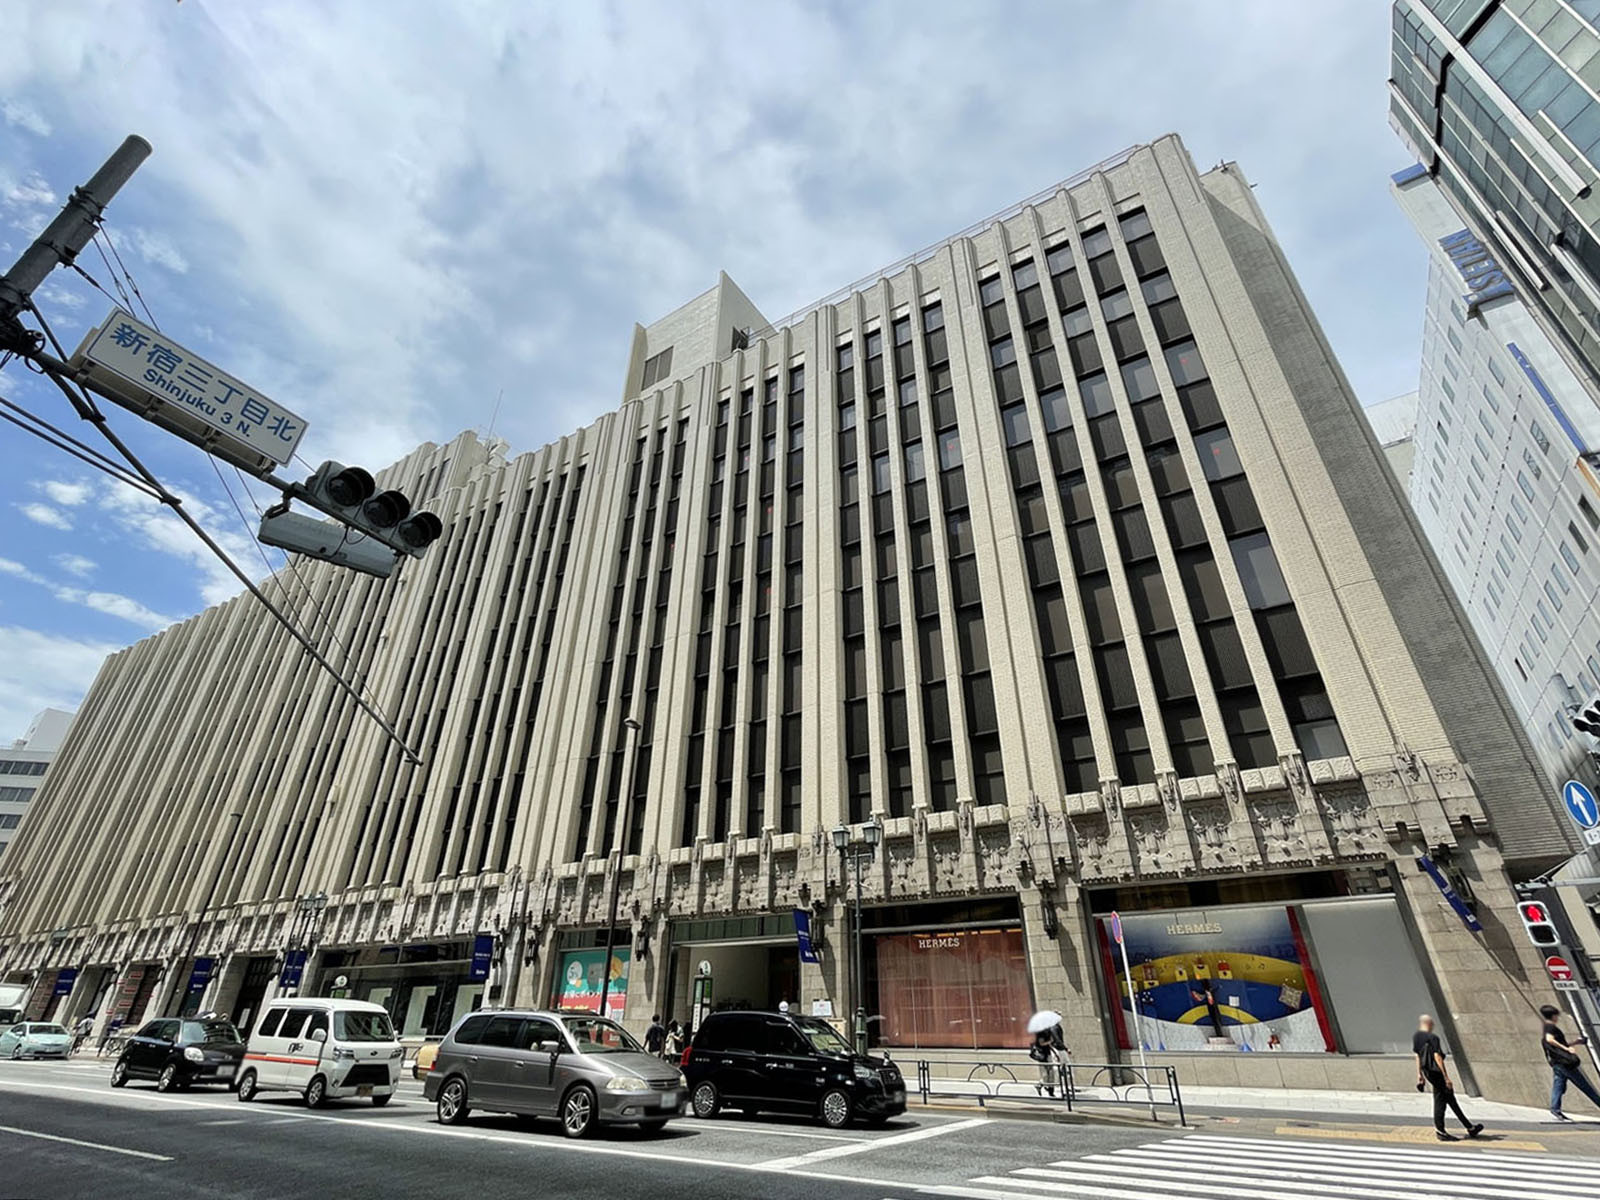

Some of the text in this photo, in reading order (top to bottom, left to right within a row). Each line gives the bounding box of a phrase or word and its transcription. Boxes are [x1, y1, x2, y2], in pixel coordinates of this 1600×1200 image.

[1438, 228, 1515, 305] ISETAN
[110, 322, 297, 442] 新宿三丁目北
[143, 368, 251, 437] Shinjuku 3 N.
